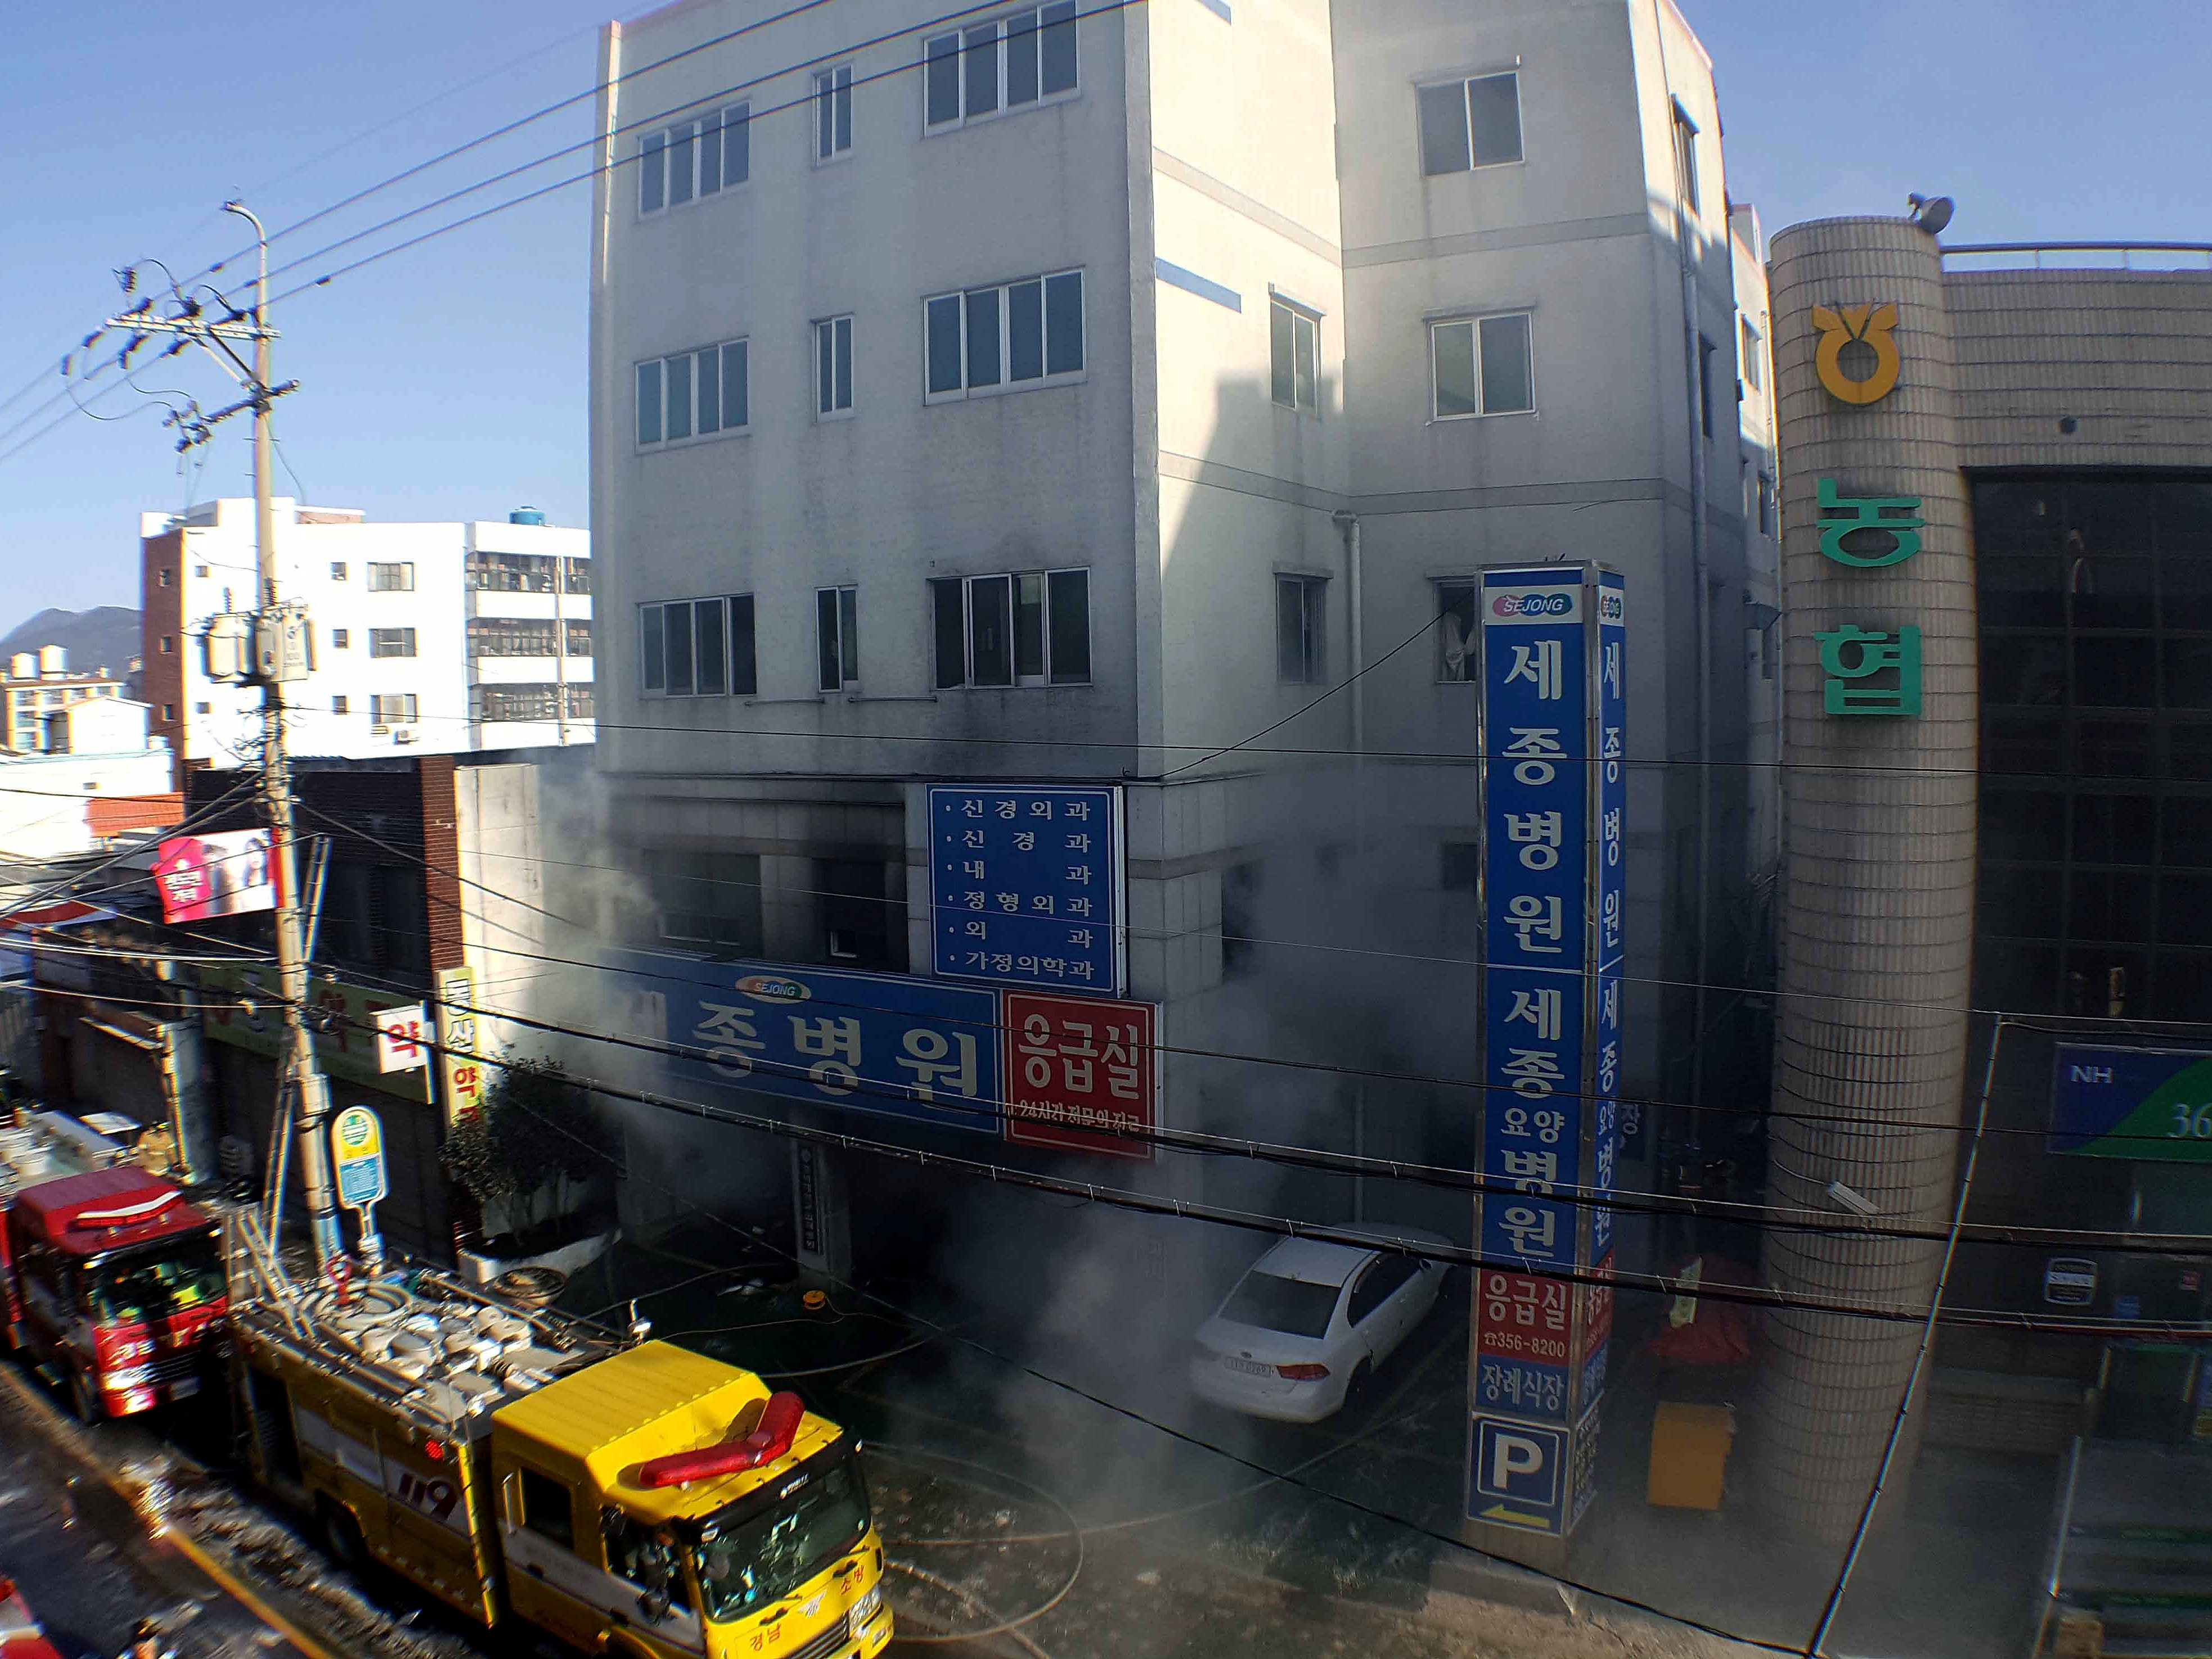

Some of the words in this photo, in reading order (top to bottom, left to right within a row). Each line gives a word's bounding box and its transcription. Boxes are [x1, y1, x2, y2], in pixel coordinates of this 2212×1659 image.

[1504, 595, 1564, 613] SEJONG
[1813, 477, 1925, 715] 농협
[960, 799, 1090, 821] 신경외과
[1501, 640, 1567, 953] 세종병원
[1603, 642, 1620, 948] 세종병원
[963, 890, 1093, 917] 정형외과
[965, 951, 1094, 980] 가정의학과
[753, 982, 795, 996] SEJONG
[387, 1020, 420, 1058] 약
[1018, 1013, 1139, 1100] 응급실
[2070, 1065, 2112, 1083] NH
[1485, 1274, 1566, 1330] 응급실
[1498, 1332, 1566, 1358] 356-8200
[1482, 1364, 1565, 1411] 장례식장
[1492, 1432, 1542, 1489] P
[398, 1473, 456, 1518] 119
[749, 1622, 782, 1651] 경남
[840, 1565, 865, 1596] 소방
